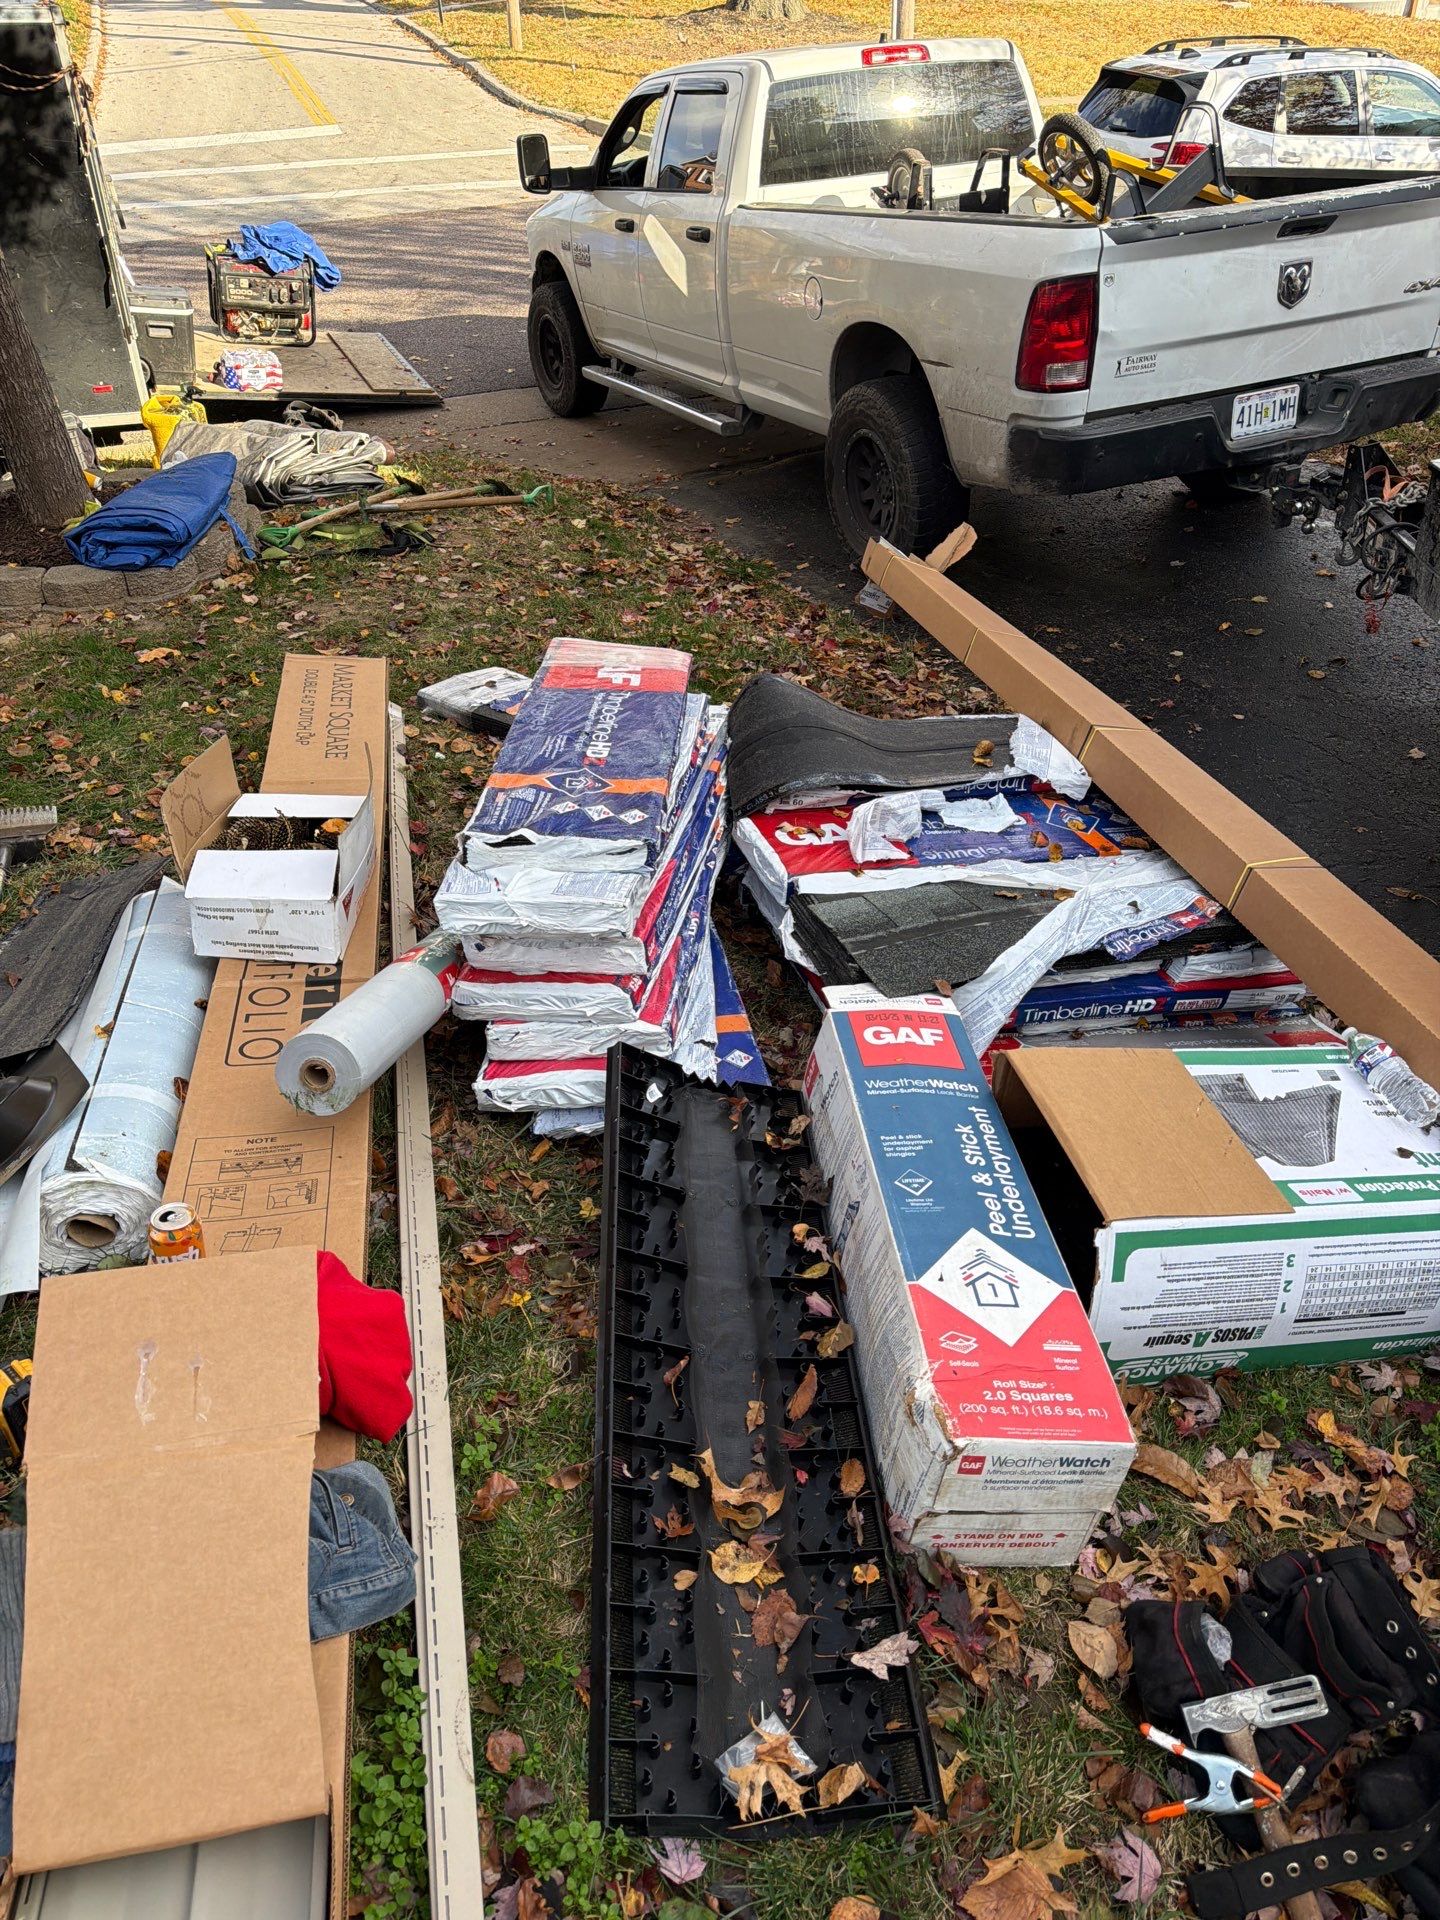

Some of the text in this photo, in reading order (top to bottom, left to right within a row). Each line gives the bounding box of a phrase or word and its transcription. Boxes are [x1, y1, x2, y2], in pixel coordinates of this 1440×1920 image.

[1236, 396, 1296, 428] 41H 1MH
[303, 669, 319, 693] DOUBLE
[325, 663, 356, 759] MARKET SQUARE
[298, 708, 314, 732] DUTCH
[774, 823, 848, 846] GA
[276, 943, 319, 951] Interchangeable
[863, 1026, 944, 1046] GAF
[864, 1078, 979, 1093] WeatherWatch
[956, 1091, 979, 1099] Barrier
[249, 1148, 291, 1156] CONTRACTION
[954, 1123, 1012, 1236] Peel & Stick
[968, 1106, 1036, 1239] Underlayment
[1298, 1189, 1334, 1197] Nails
[1354, 1179, 1436, 1194] Protection
[1286, 1254, 1295, 1268] 3
[1283, 1280, 1293, 1293] 2
[1280, 1302, 1287, 1314] 1
[1143, 1333, 1192, 1349] Seguir
[1192, 1331, 1212, 1348] A
[1211, 1326, 1256, 1343] PASOS
[1151, 1354, 1202, 1367] VENTS
[1114, 1359, 1231, 1380] LOMANCO
[993, 1380, 1016, 1388] Roll
[983, 1390, 1074, 1402] 2.0 Squares
[959, 1403, 1108, 1420] (200 sq. ft.) (18.6 sq. m.)
[961, 1456, 1111, 1469] GAF WeatherWatch
